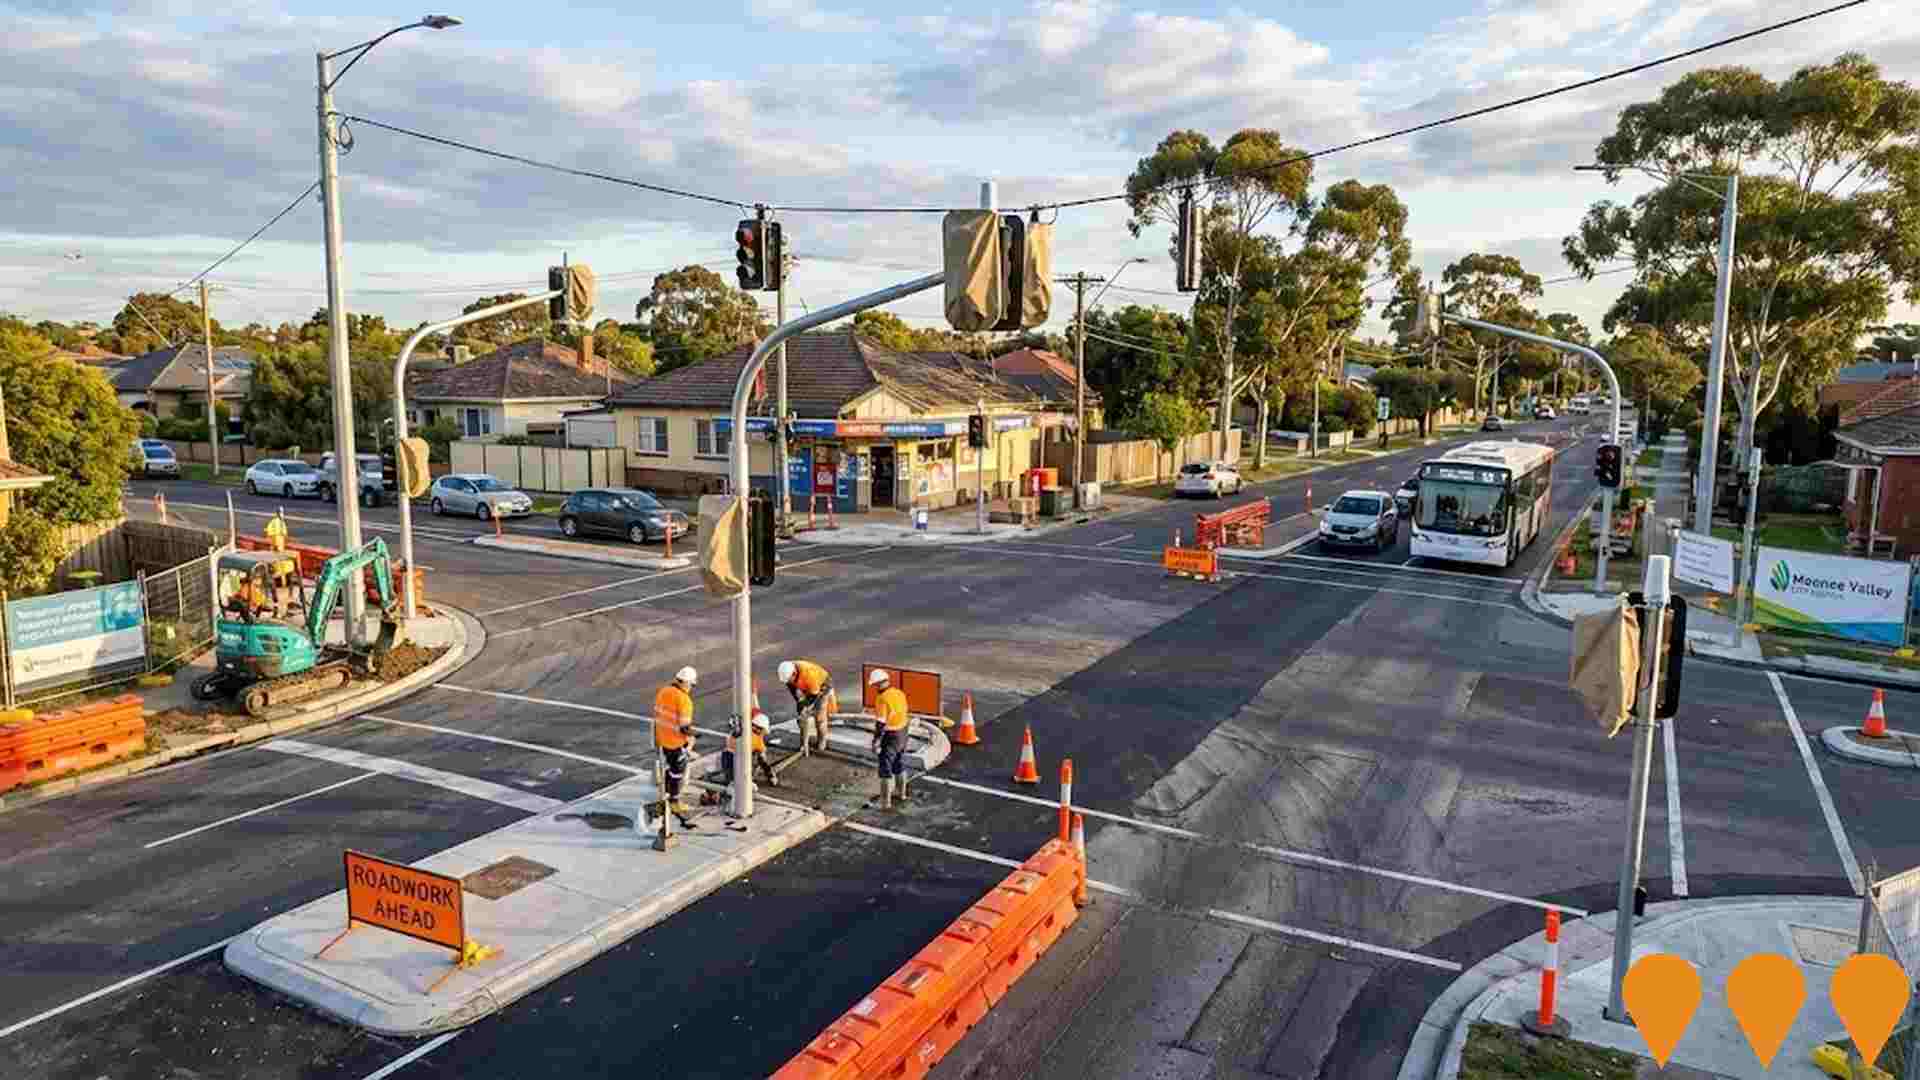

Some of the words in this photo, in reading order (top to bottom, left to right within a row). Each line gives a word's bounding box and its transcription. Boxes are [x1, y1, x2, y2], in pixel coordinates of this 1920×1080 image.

[1793, 575, 1845, 591] Moonee
[1849, 581, 1893, 598] Valley
[353, 865, 454, 910] ROADWORK
[375, 899, 435, 929] AHEAD
